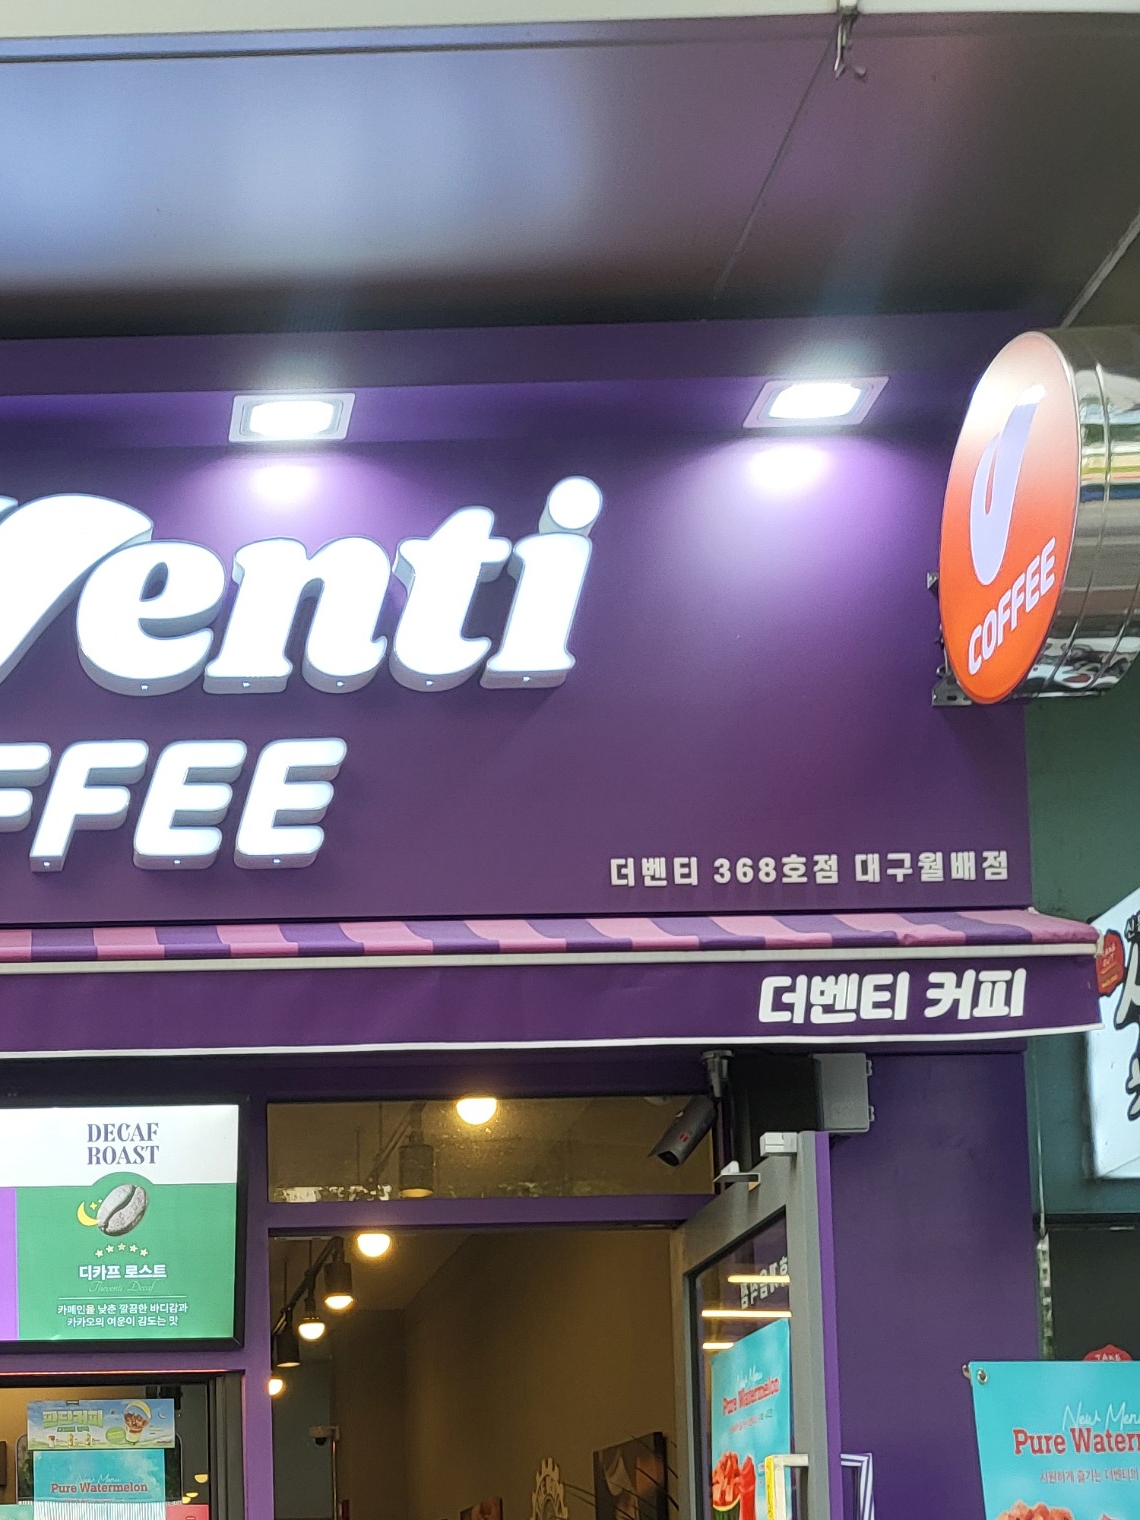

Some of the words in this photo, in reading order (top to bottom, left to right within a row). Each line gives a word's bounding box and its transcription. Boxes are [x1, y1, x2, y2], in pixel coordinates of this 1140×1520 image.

[968, 536, 1056, 676] COFFEE
[610, 857, 699, 887] 더벤티
[713, 854, 839, 885] 368호점
[854, 850, 1009, 883] 대구월배점
[759, 970, 910, 1024] 더벤티
[924, 967, 1027, 1020] 커피
[87, 1122, 159, 1143] DECAF
[87, 1145, 160, 1165] ROAST
[79, 1265, 122, 1280] 디카프
[124, 1264, 167, 1279] 로스트
[150, 1303, 188, 1314] 바디감과
[169, 1316, 179, 1326] 맛
[1062, 1401, 1101, 1431] New
[1106, 1401, 1140, 1431] Men
[1013, 1427, 1066, 1455] Pure
[51, 1483, 77, 1494] Pure
[79, 1481, 148, 1494] Watermelon
